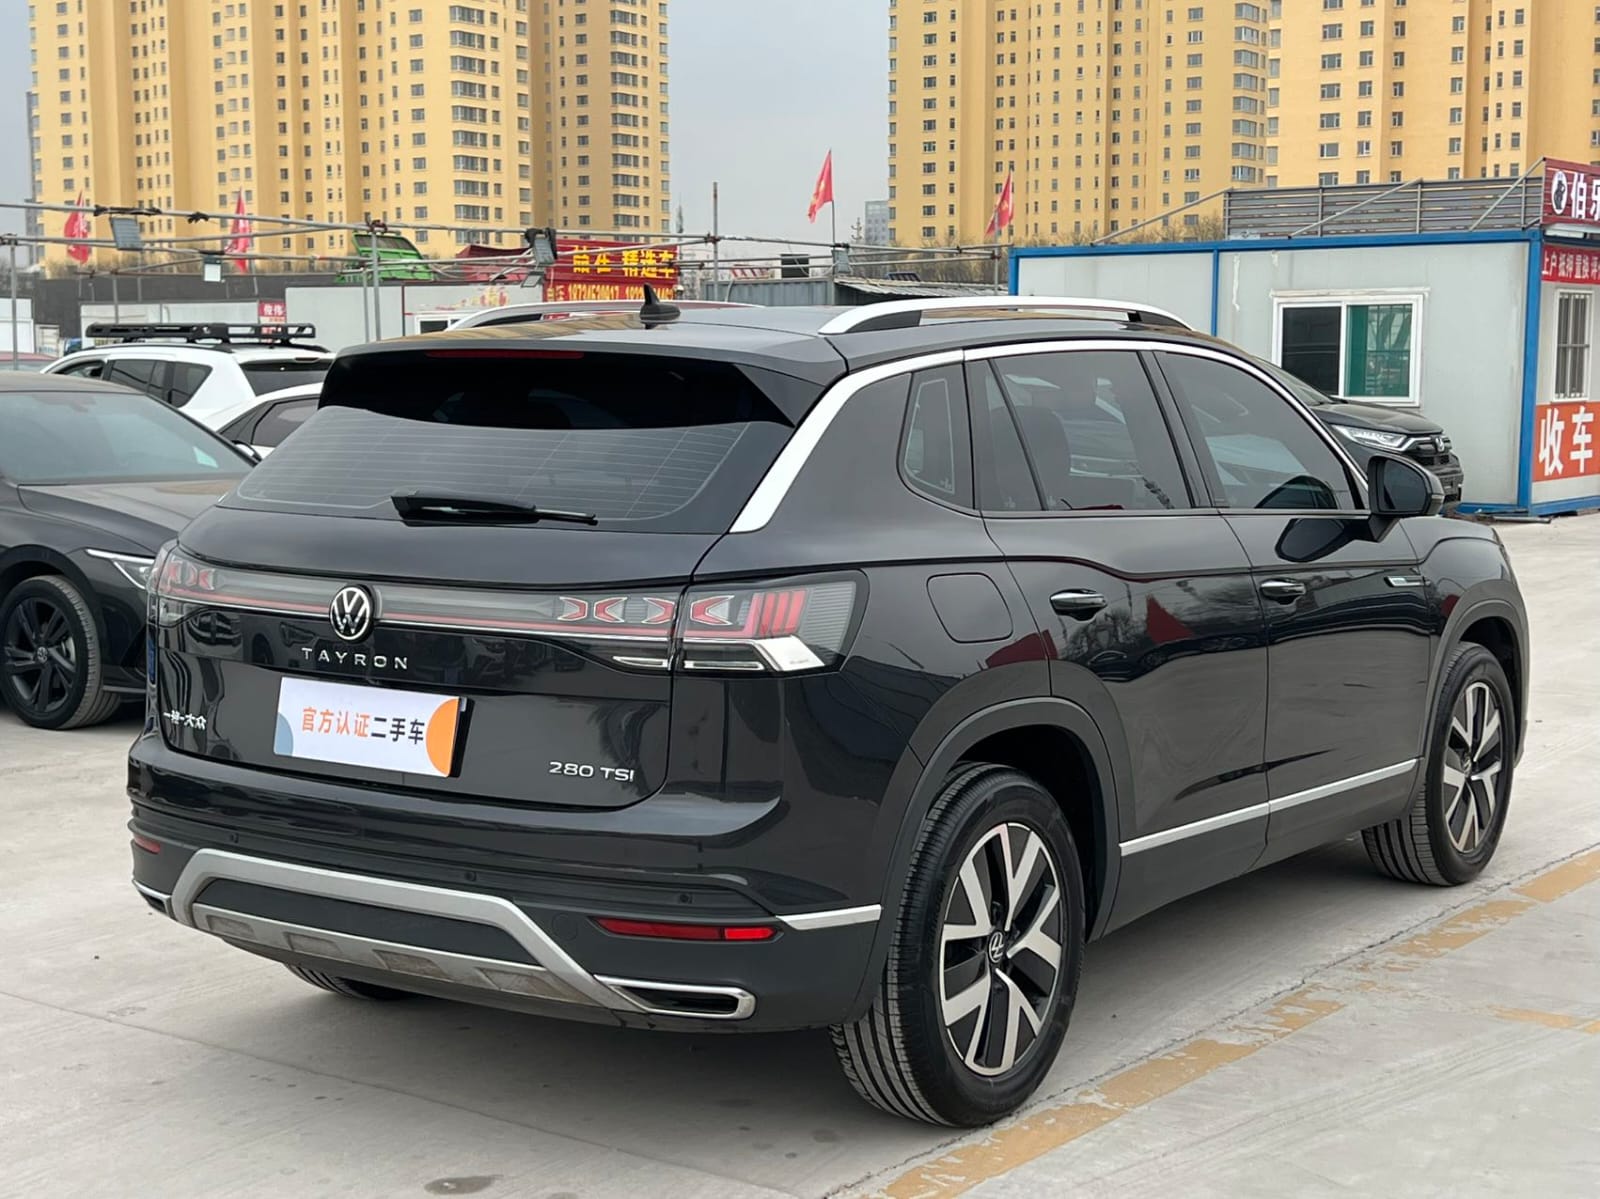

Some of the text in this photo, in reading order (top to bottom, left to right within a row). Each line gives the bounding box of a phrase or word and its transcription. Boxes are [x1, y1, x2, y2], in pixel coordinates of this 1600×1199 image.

[1538, 405, 1595, 477] 收车
[301, 647, 409, 670] TAYRON
[302, 706, 426, 745] 官方认证二手车
[548, 761, 635, 782] 280 TSI
